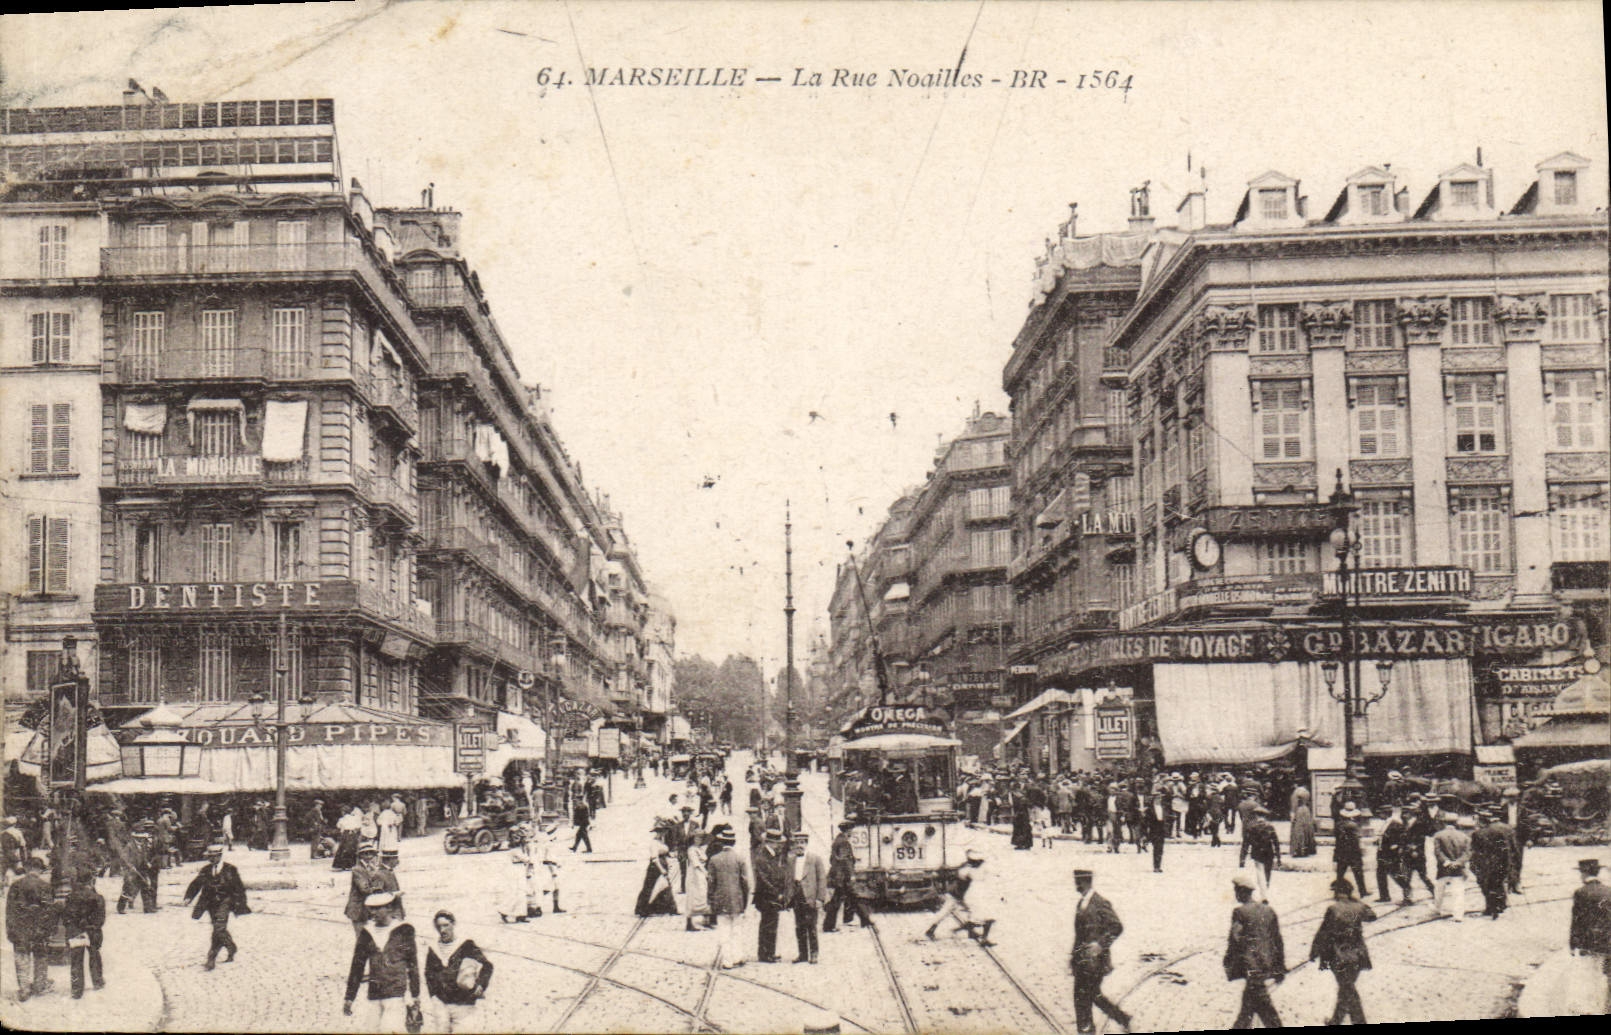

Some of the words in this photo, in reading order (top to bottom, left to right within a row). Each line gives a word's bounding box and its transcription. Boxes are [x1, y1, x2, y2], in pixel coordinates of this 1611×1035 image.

[157, 457, 176, 477] LA
[186, 454, 262, 476] MONDIALE
[1081, 512, 1103, 535] LA
[1403, 568, 1472, 593] ZENITH
[127, 582, 322, 610] DENTISTE
[1149, 634, 1171, 657] DE
[1176, 633, 1255, 658] VOYAGE
[1350, 628, 1467, 654] BAZAR
[1472, 622, 1570, 648] IGARO
[871, 706, 926, 724] OMEGA
[324, 723, 432, 743] PIPES
[896, 846, 924, 860] 591
